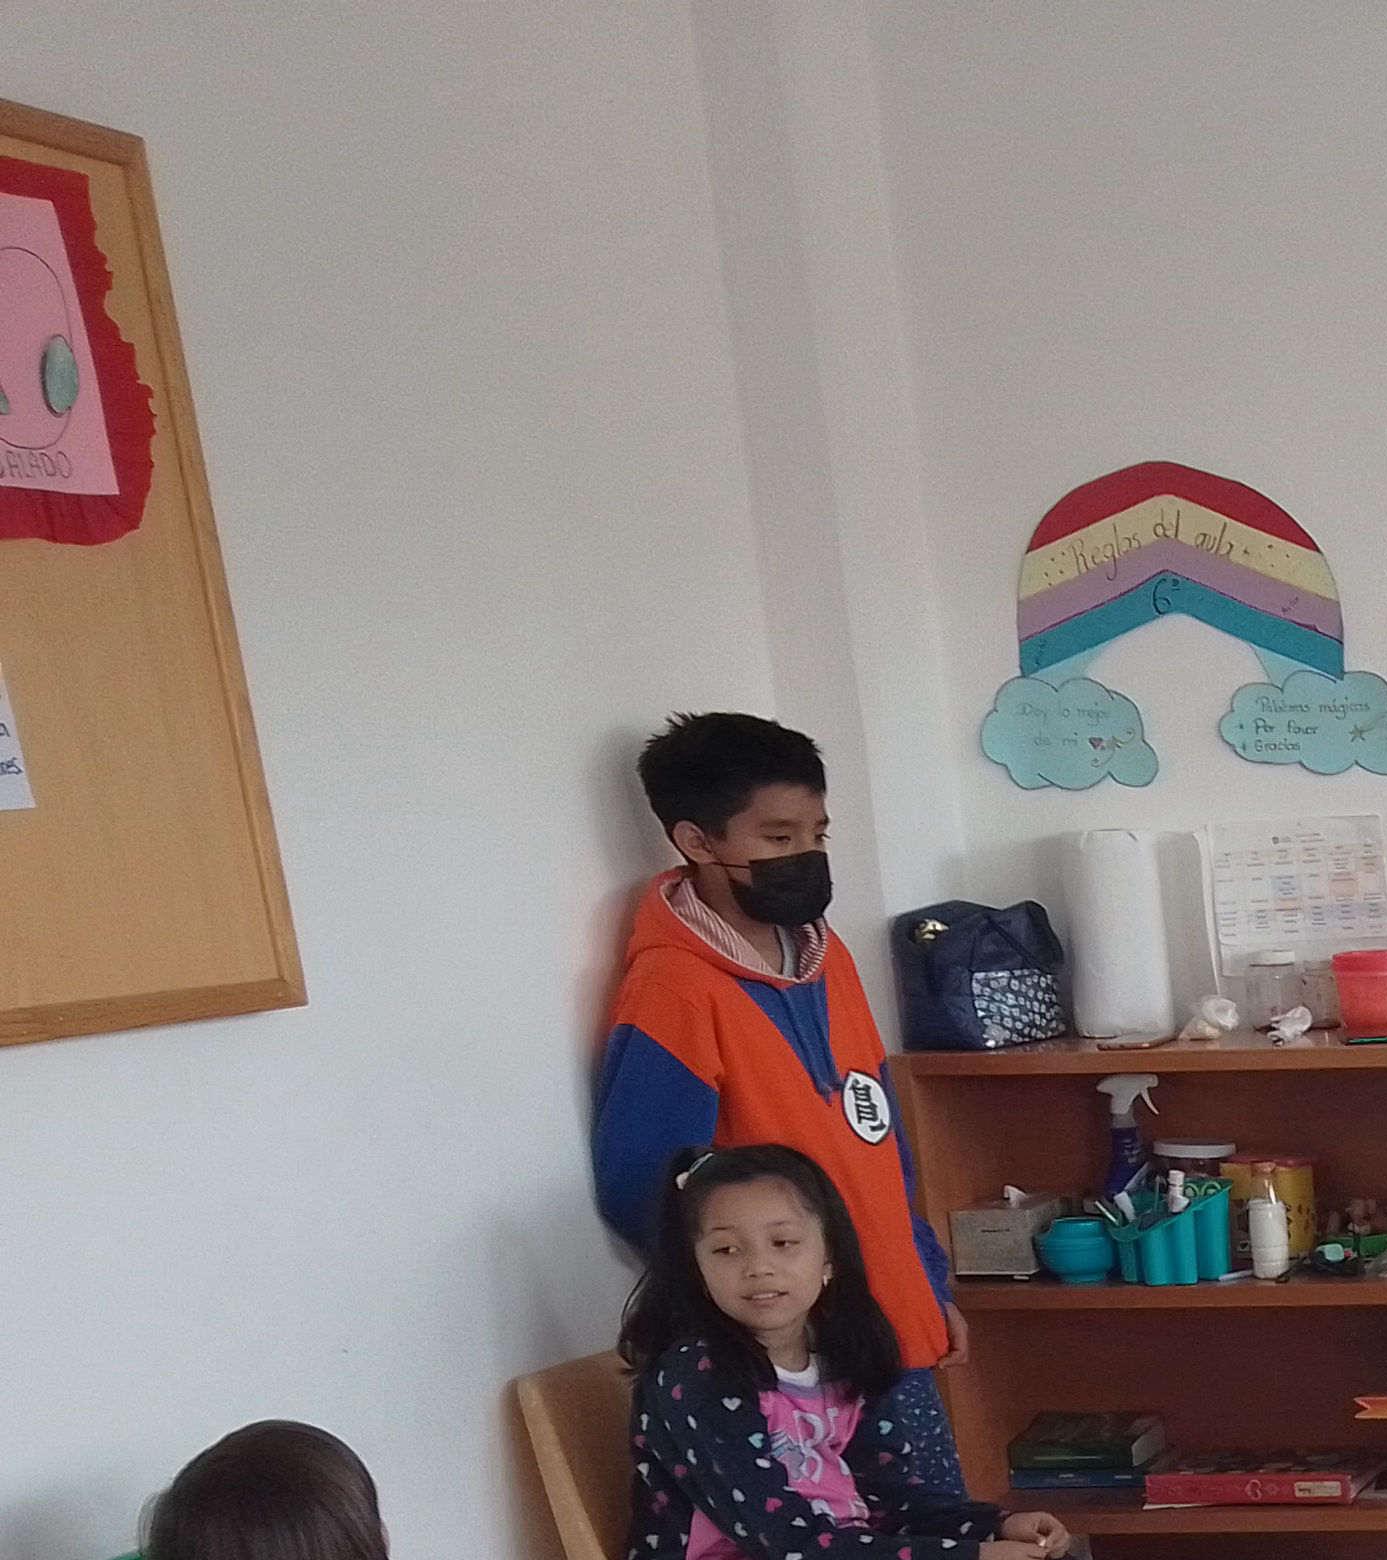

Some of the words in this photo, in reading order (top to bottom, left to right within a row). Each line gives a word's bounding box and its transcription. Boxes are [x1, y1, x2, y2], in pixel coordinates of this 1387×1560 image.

[0, 450, 72, 480] ALADO
[1153, 508, 1181, 539] del
[1194, 521, 1236, 556] aula
